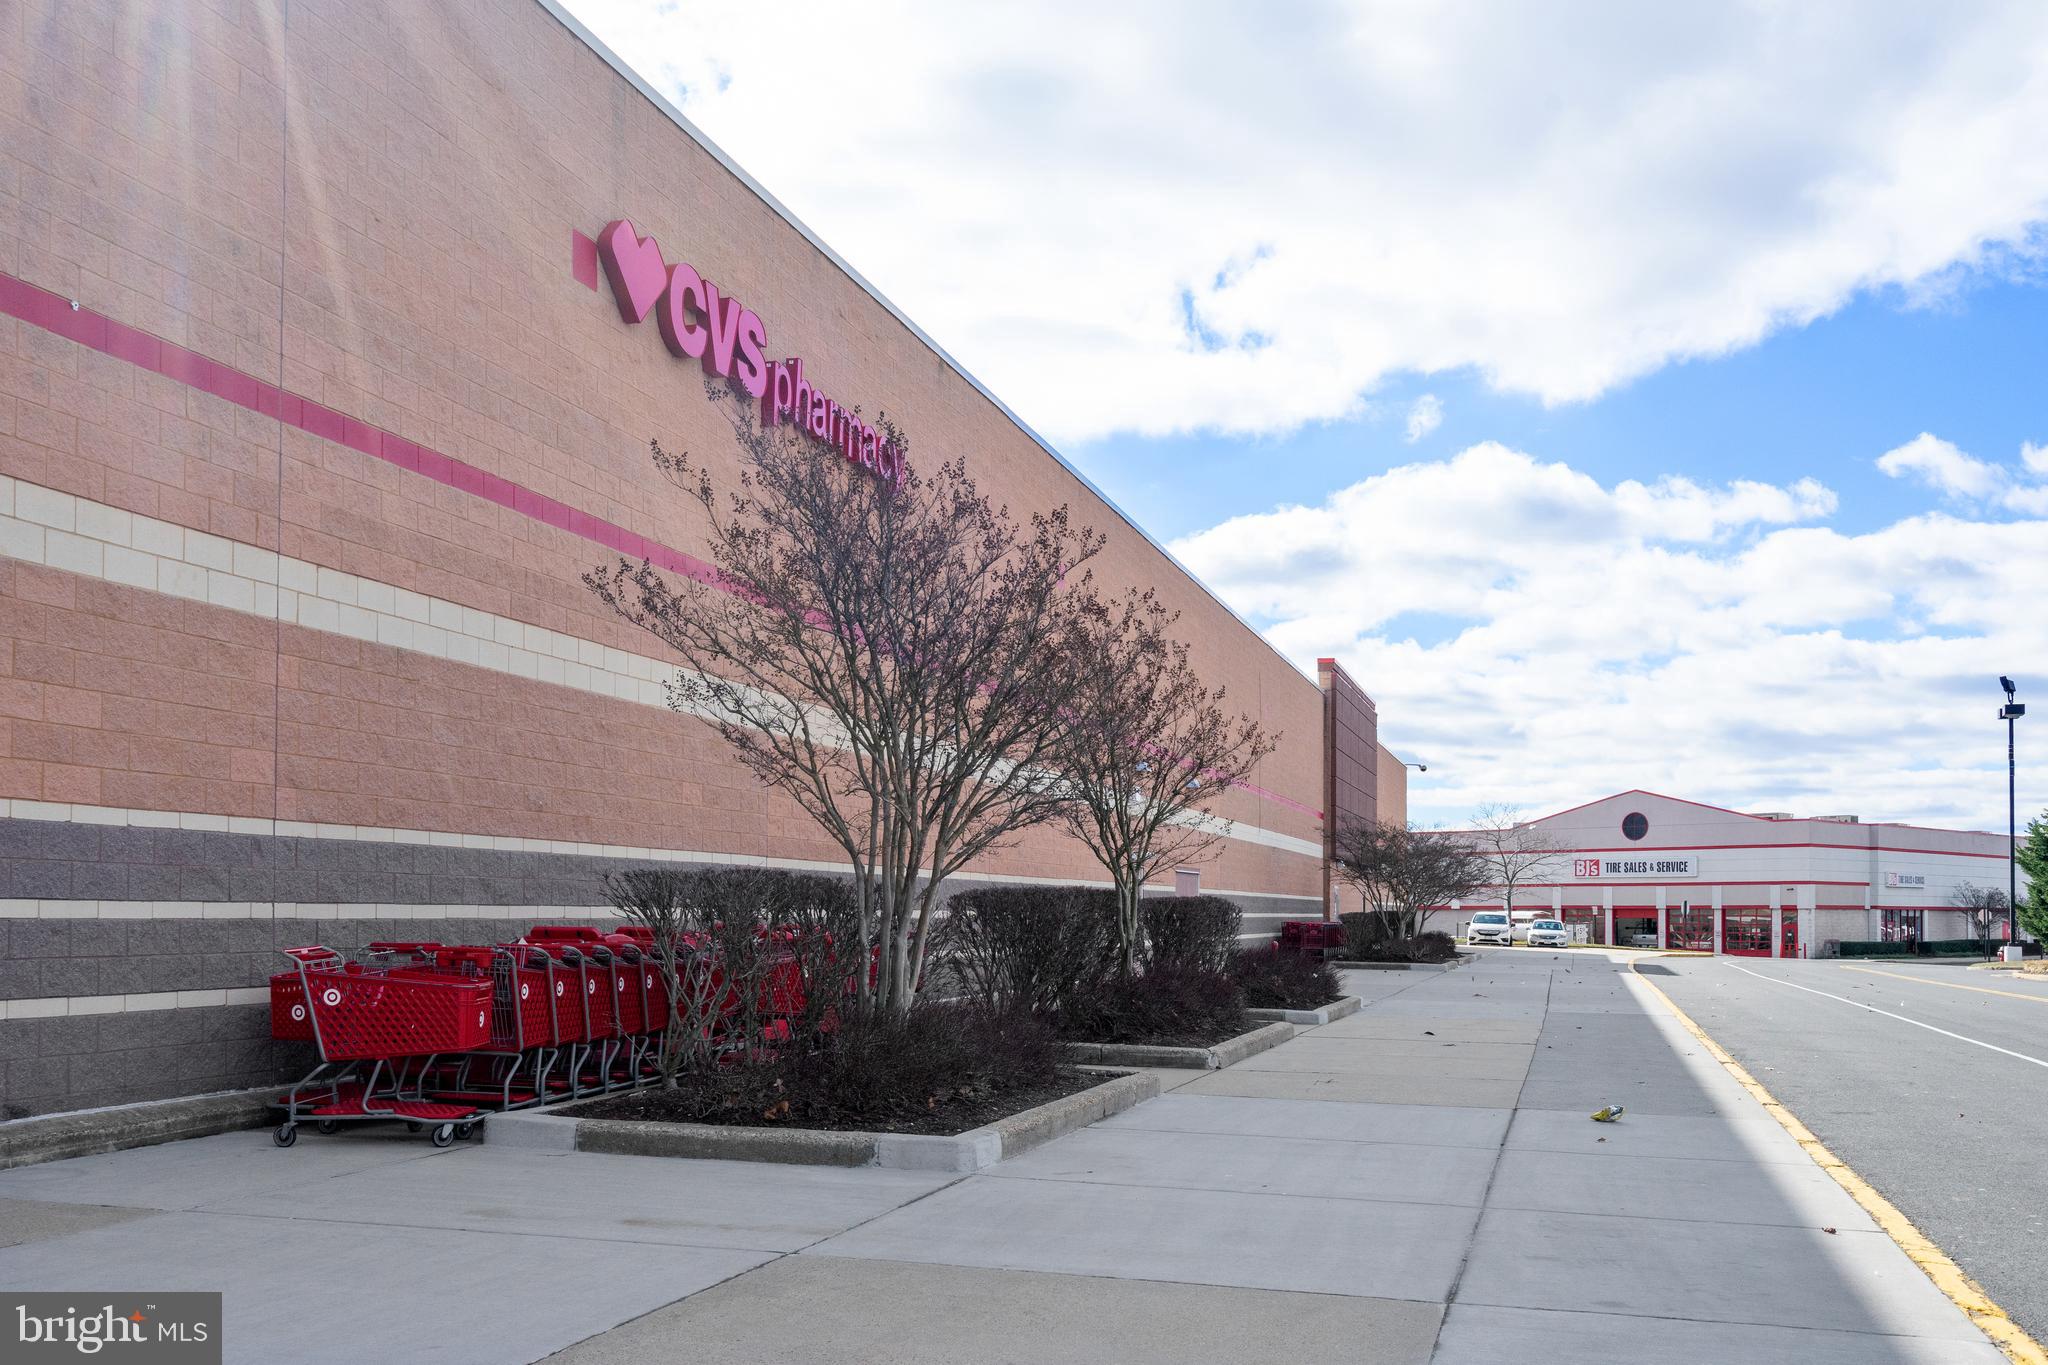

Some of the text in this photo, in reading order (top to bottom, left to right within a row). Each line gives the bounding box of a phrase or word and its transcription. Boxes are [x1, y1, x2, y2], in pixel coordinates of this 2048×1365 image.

[659, 263, 767, 398] CVS
[1606, 862, 1621, 873] TIRE
[1624, 862, 1647, 873] SALES
[1650, 862, 1654, 872] &
[1657, 861, 1688, 873] SERVICE
